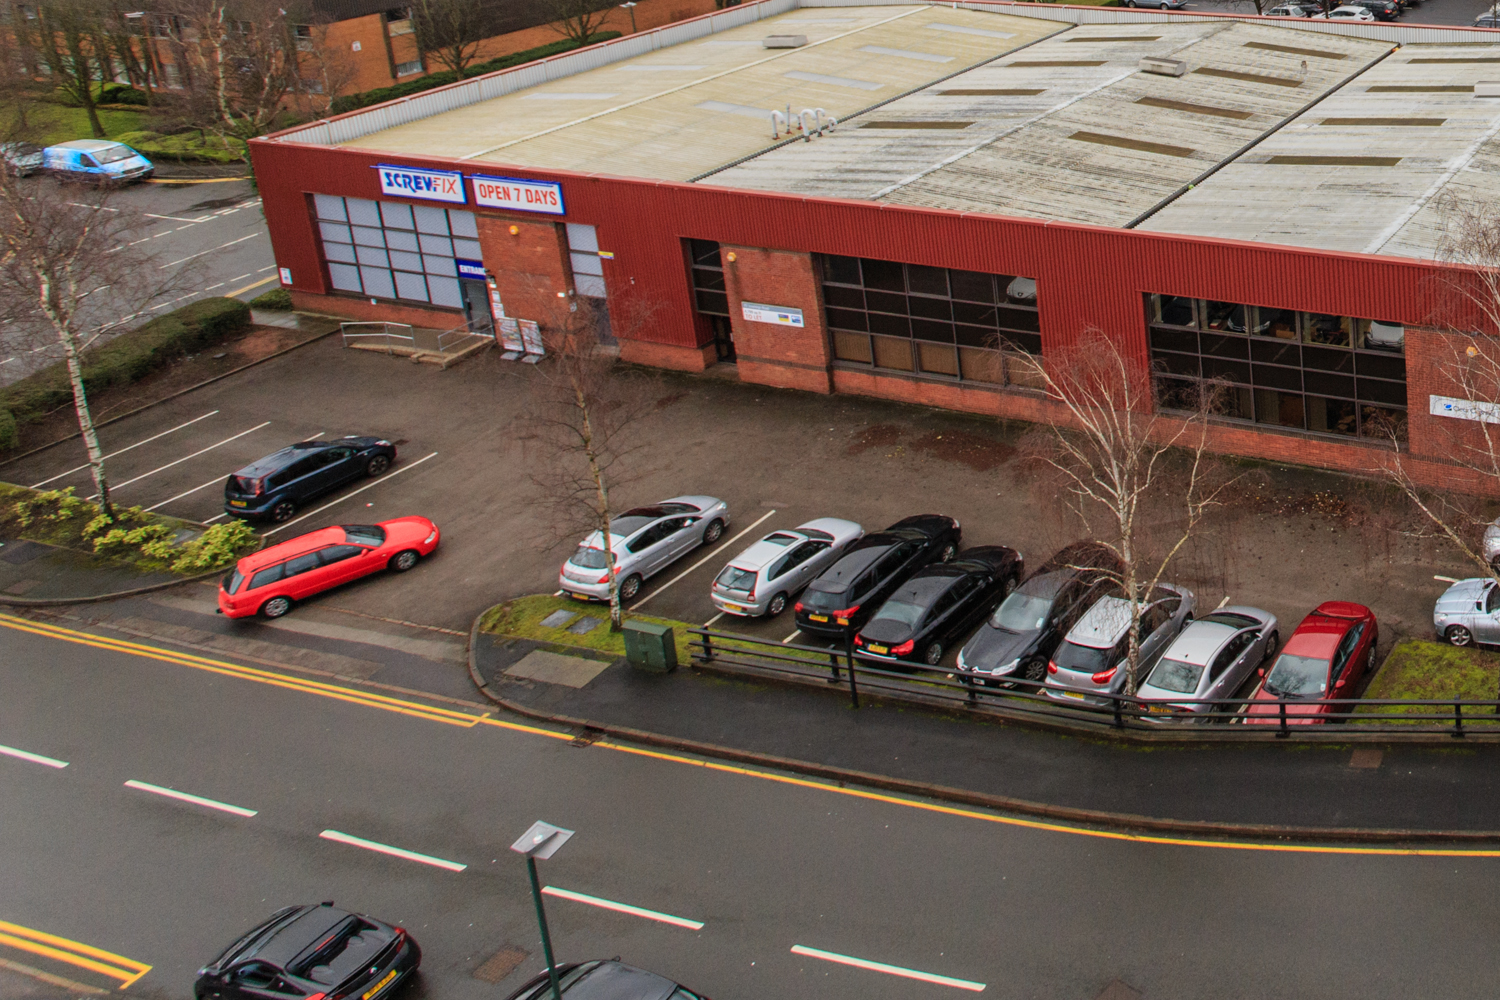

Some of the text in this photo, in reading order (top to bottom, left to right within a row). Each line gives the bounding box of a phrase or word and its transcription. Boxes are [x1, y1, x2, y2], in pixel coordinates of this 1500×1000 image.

[384, 172, 457, 195] SCREWFIX
[479, 183, 558, 206] OPEN 7 DAYS
[458, 264, 487, 276] ENTRANC
